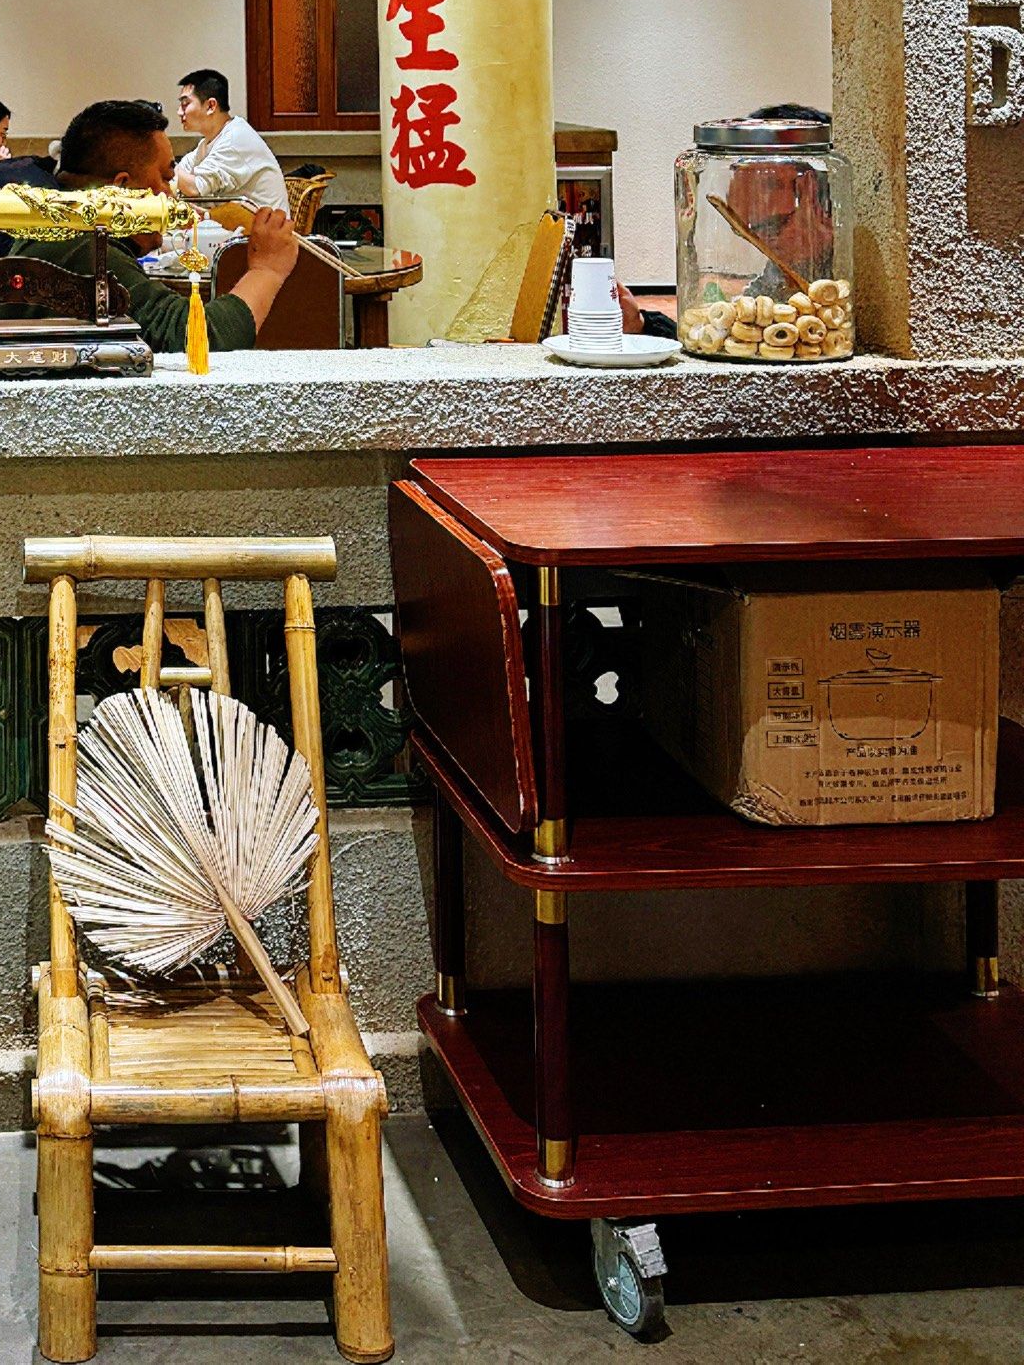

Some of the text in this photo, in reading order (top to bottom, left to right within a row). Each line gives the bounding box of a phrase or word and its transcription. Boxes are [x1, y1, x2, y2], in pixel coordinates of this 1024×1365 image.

[829, 619, 921, 641] 烟雾演示器
